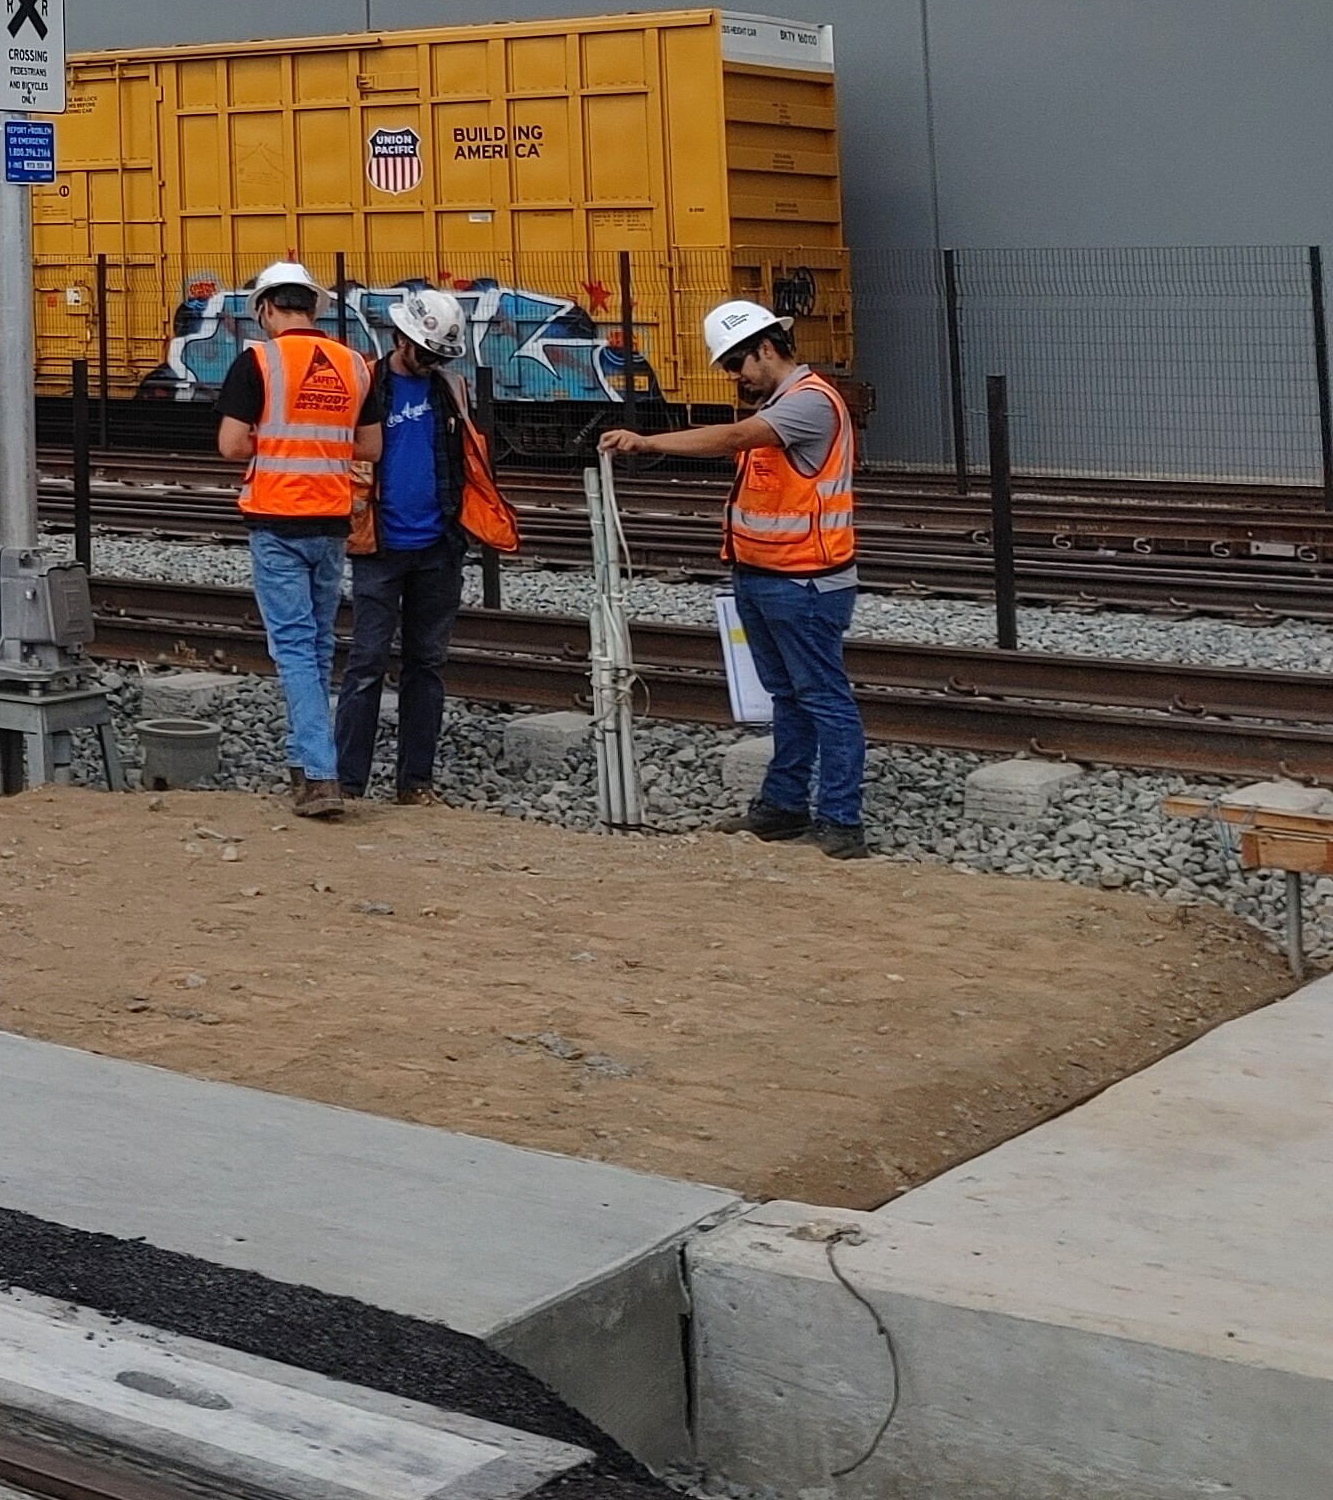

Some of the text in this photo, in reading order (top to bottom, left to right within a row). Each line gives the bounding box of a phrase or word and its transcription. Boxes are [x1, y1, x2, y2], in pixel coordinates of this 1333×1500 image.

[8, 48, 48, 63] CROSSING
[10, 66, 47, 77] PEDESTRIANS
[9, 81, 48, 91] AND BICYCLES
[21, 95, 37, 105] ONLY
[376, 134, 412, 145] UNION
[453, 125, 543, 143] BUILDING
[374, 145, 415, 155] PACIFIC
[312, 375, 339, 385] SAFETY
[296, 392, 352, 405] NOBODY
